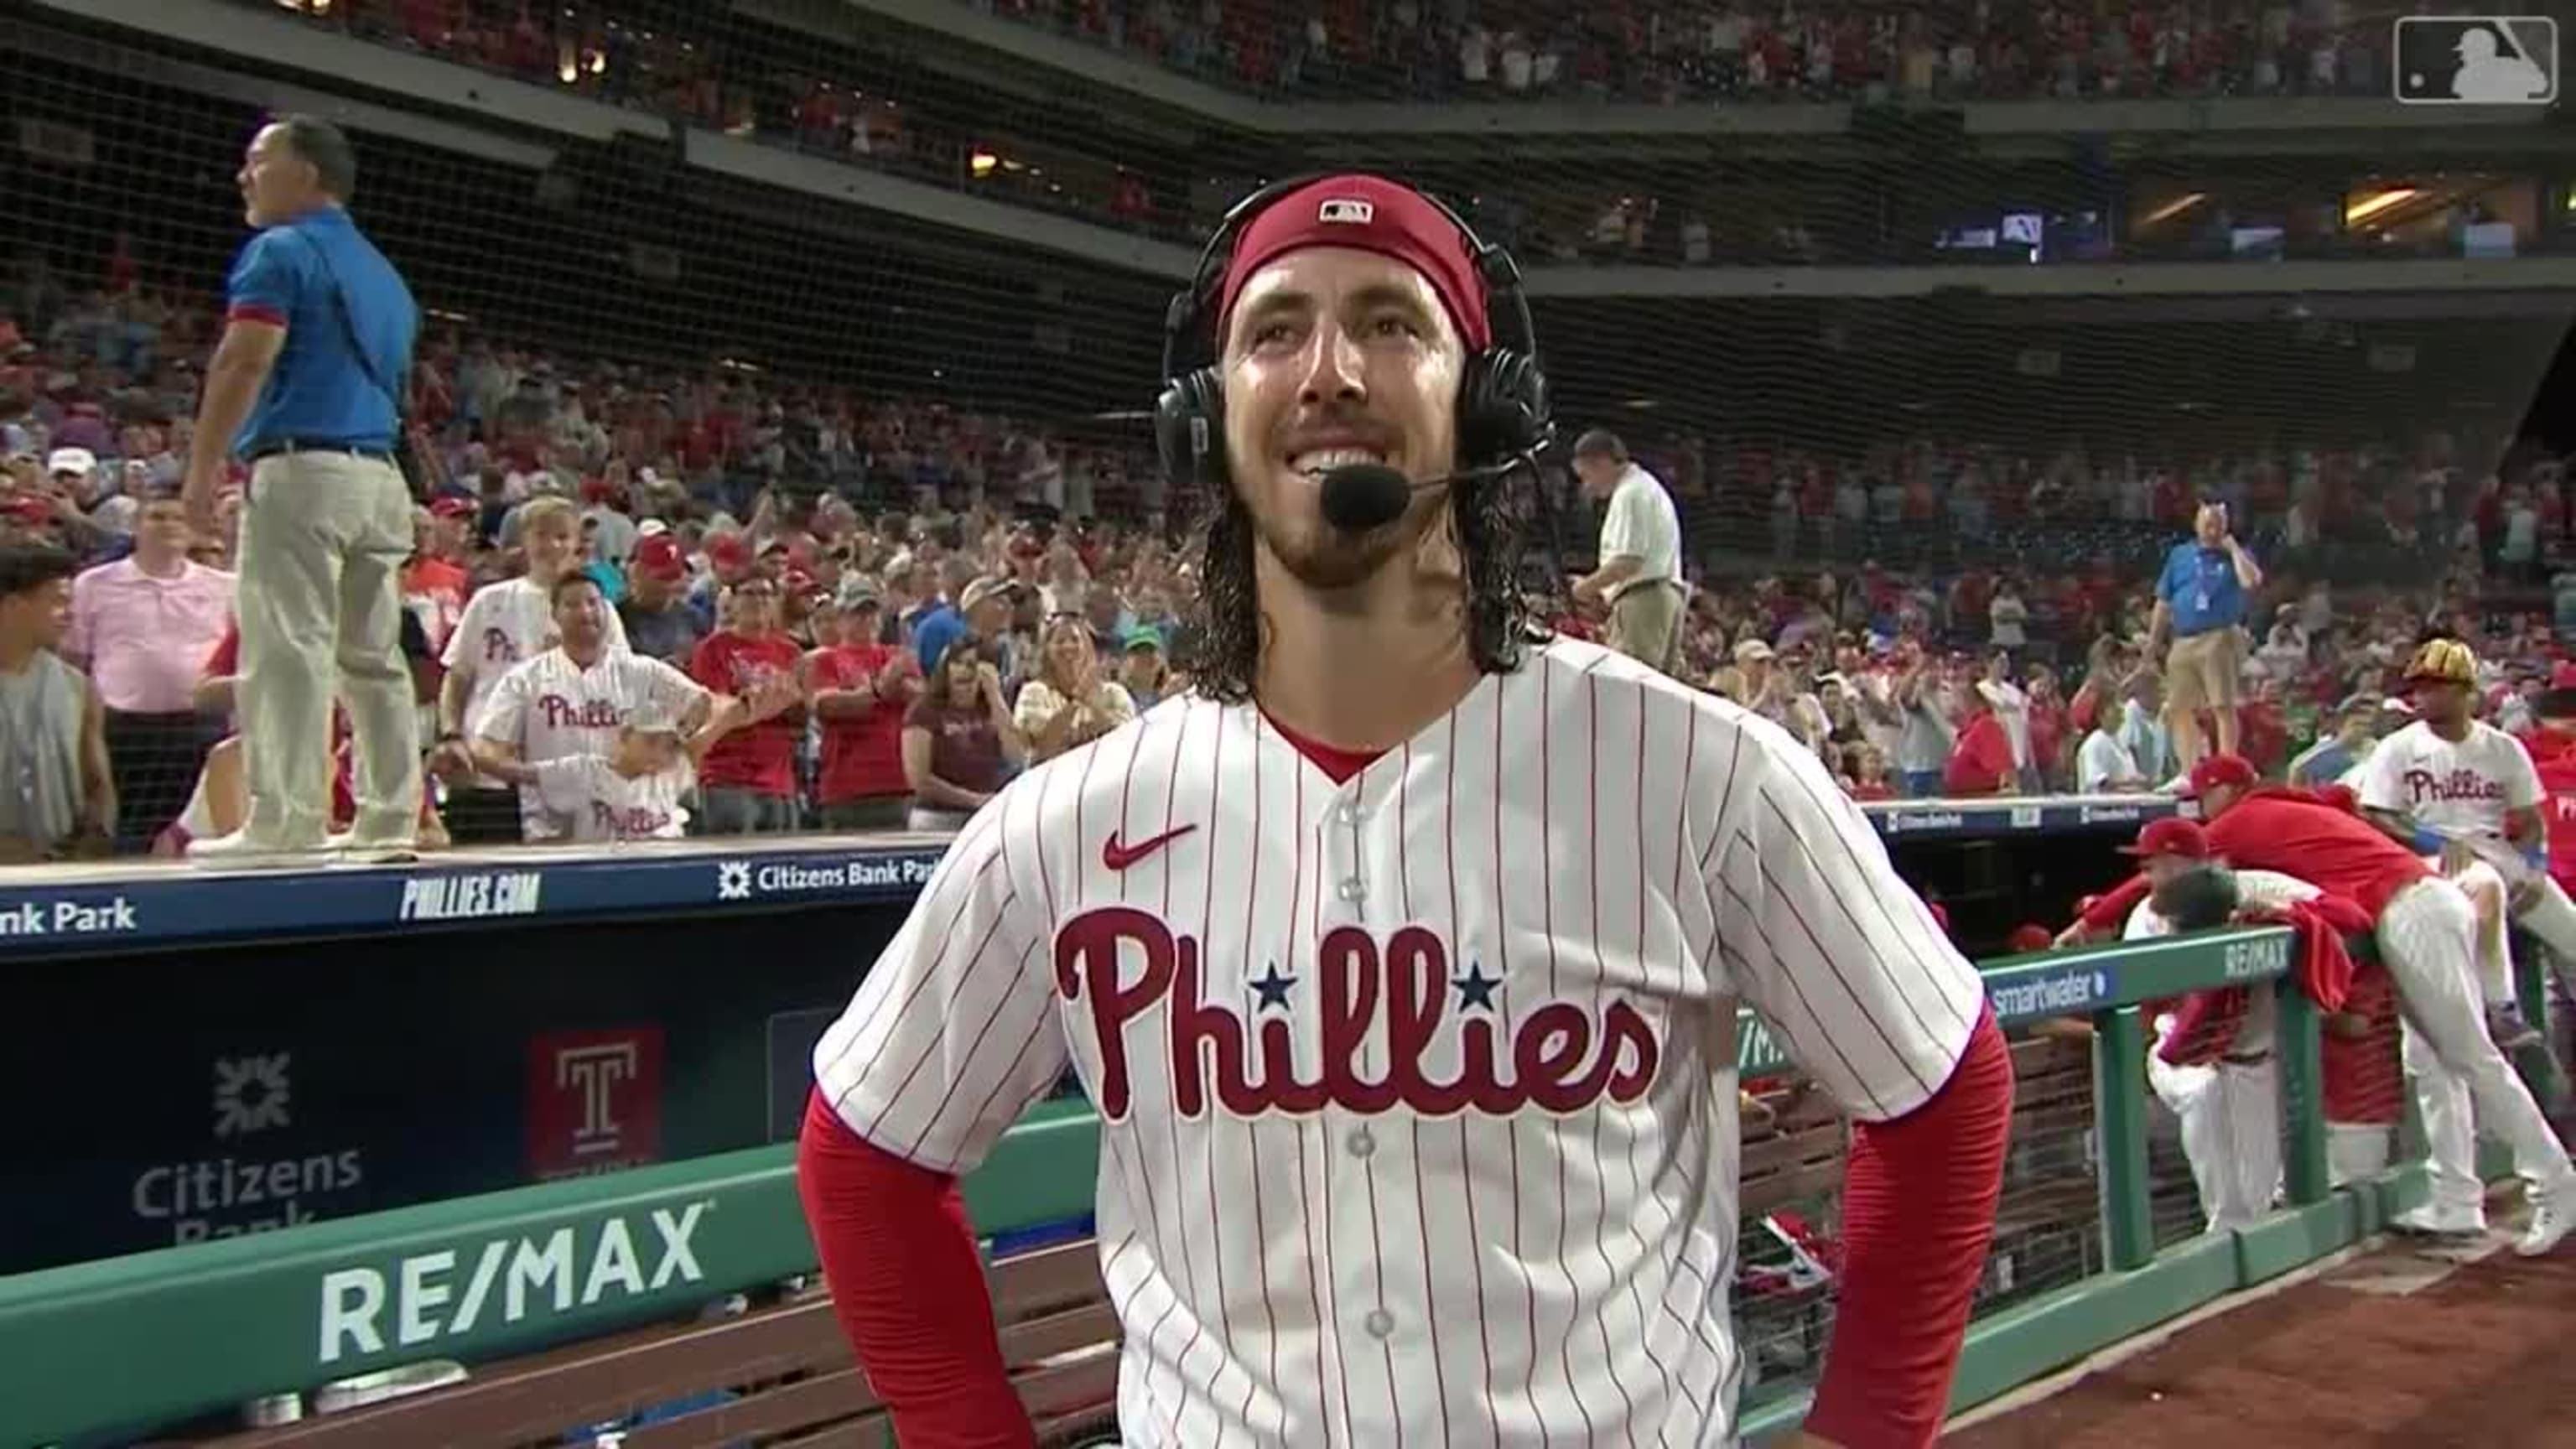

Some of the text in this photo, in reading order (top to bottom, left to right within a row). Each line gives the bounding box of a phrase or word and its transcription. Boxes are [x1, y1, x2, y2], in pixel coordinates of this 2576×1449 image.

[538, 693, 618, 730] Philli
[757, 865, 844, 890] Citizens
[847, 860, 901, 886] Bank
[0, 896, 138, 934] nk Park
[1053, 906, 1660, 1121] Phillies
[1994, 970, 2091, 1018] smartwater
[132, 1150, 364, 1218] Citizens
[319, 1202, 706, 1363] RE/MAX
